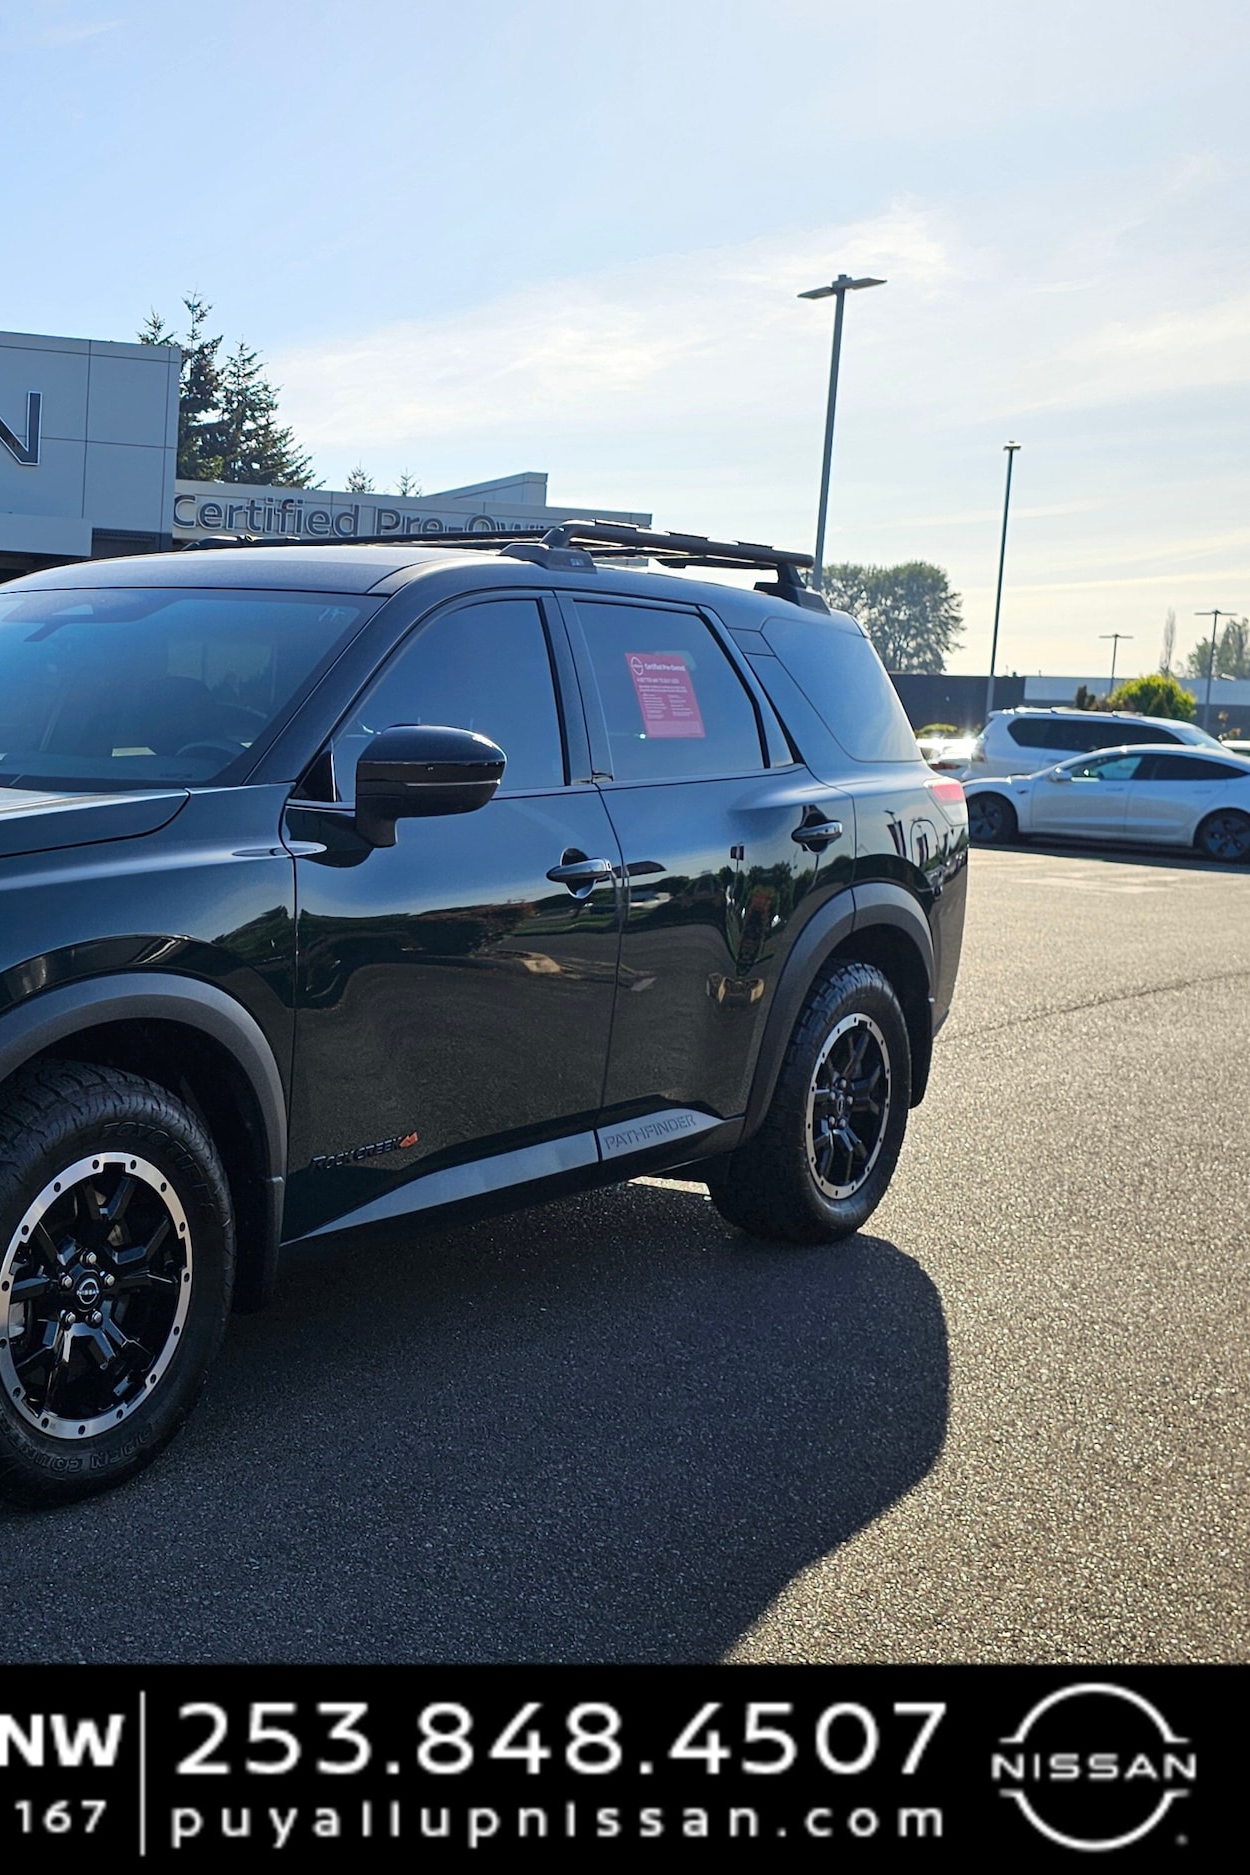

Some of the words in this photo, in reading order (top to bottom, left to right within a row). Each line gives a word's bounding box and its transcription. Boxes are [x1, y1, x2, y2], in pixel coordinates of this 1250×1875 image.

[172, 494, 361, 537] Certified
[374, 506, 560, 537] Pre-O
[603, 1113, 698, 1151] PATHFINDER
